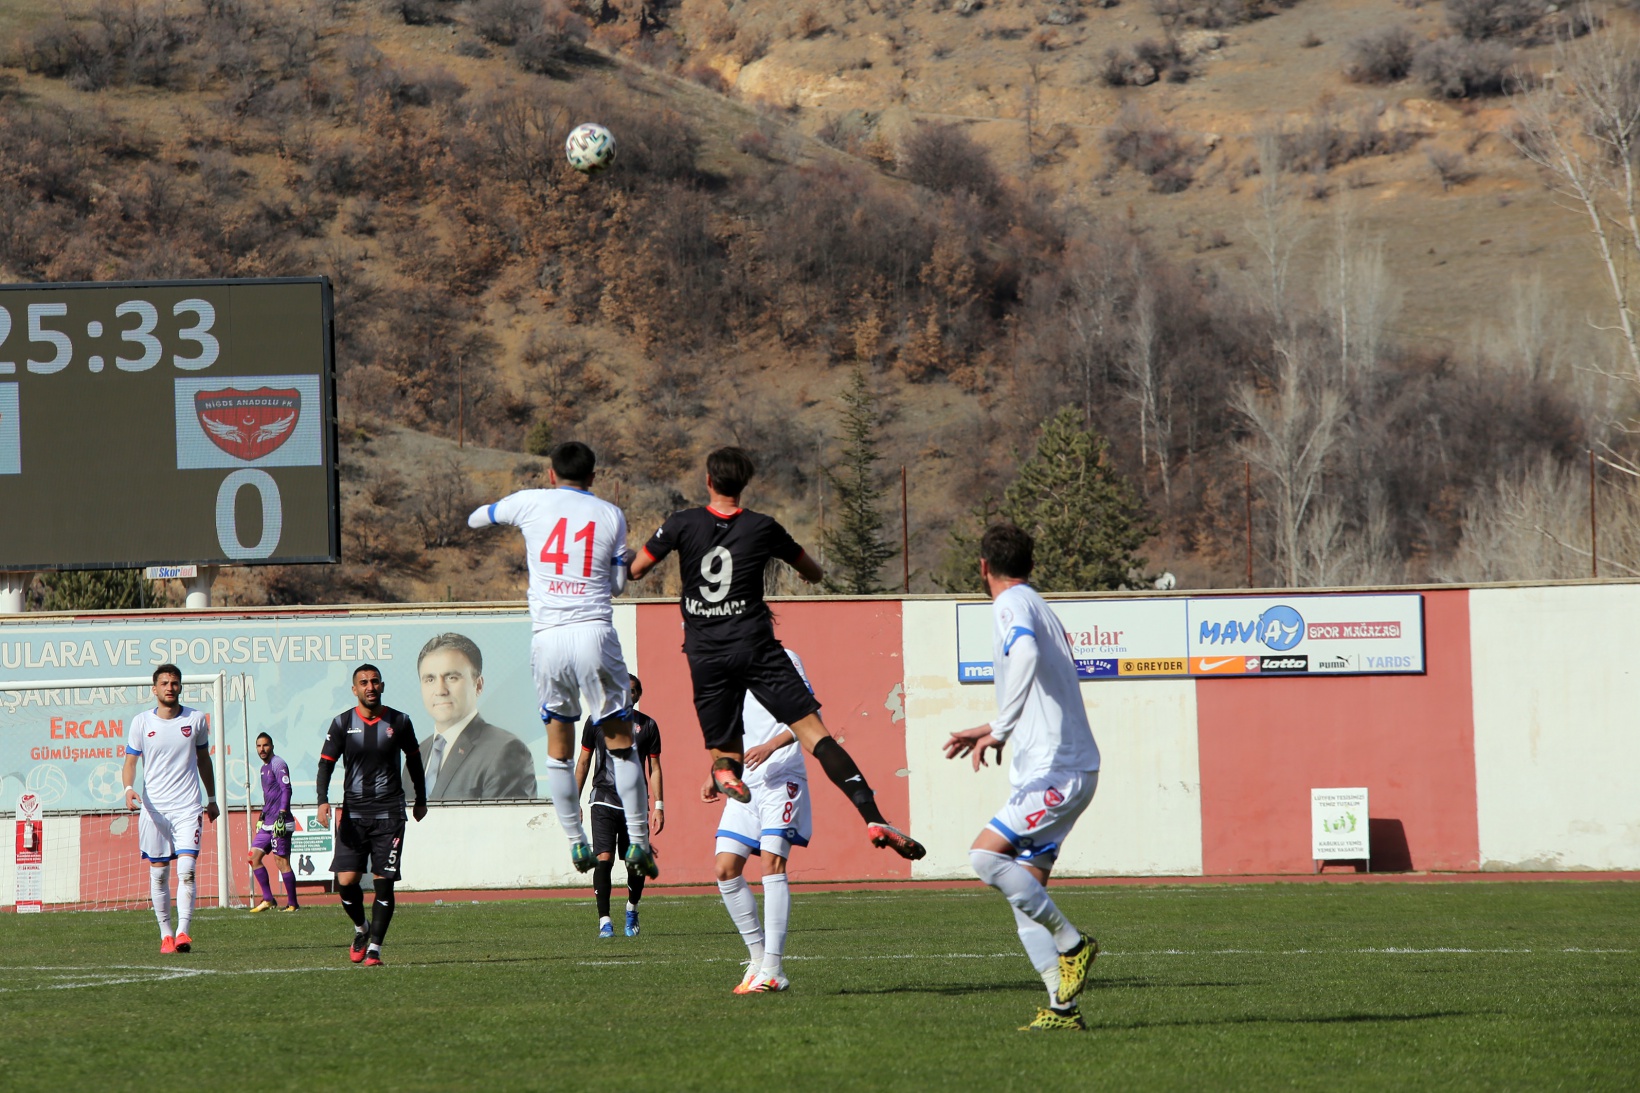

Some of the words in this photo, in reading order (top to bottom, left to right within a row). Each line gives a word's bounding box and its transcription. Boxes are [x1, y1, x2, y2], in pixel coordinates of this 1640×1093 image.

[215, 468, 282, 559] 0
[540, 517, 596, 578] 41
[158, 566, 193, 578] Skorled
[699, 546, 733, 603] 9
[547, 580, 586, 595] AKYÜZ
[1309, 626, 1340, 639] SPOR
[0, 640, 99, 669] ULARA
[103, 638, 142, 667] VE
[149, 633, 393, 665] SPORSEVERLERE
[1074, 646, 1096, 656] Spor
[1099, 644, 1128, 656] Giyim
[1137, 661, 1184, 672] GREYDER
[1366, 656, 1411, 669] YARDS
[0, 684, 127, 714] ŞARILAR
[50, 716, 123, 740] ERCAN
[30, 744, 113, 762] GÜMÜŞHANE
[782, 801, 793, 823] 8
[1025, 808, 1047, 830] 4
[194, 829, 200, 845] 5
[388, 849, 398, 865] 5
